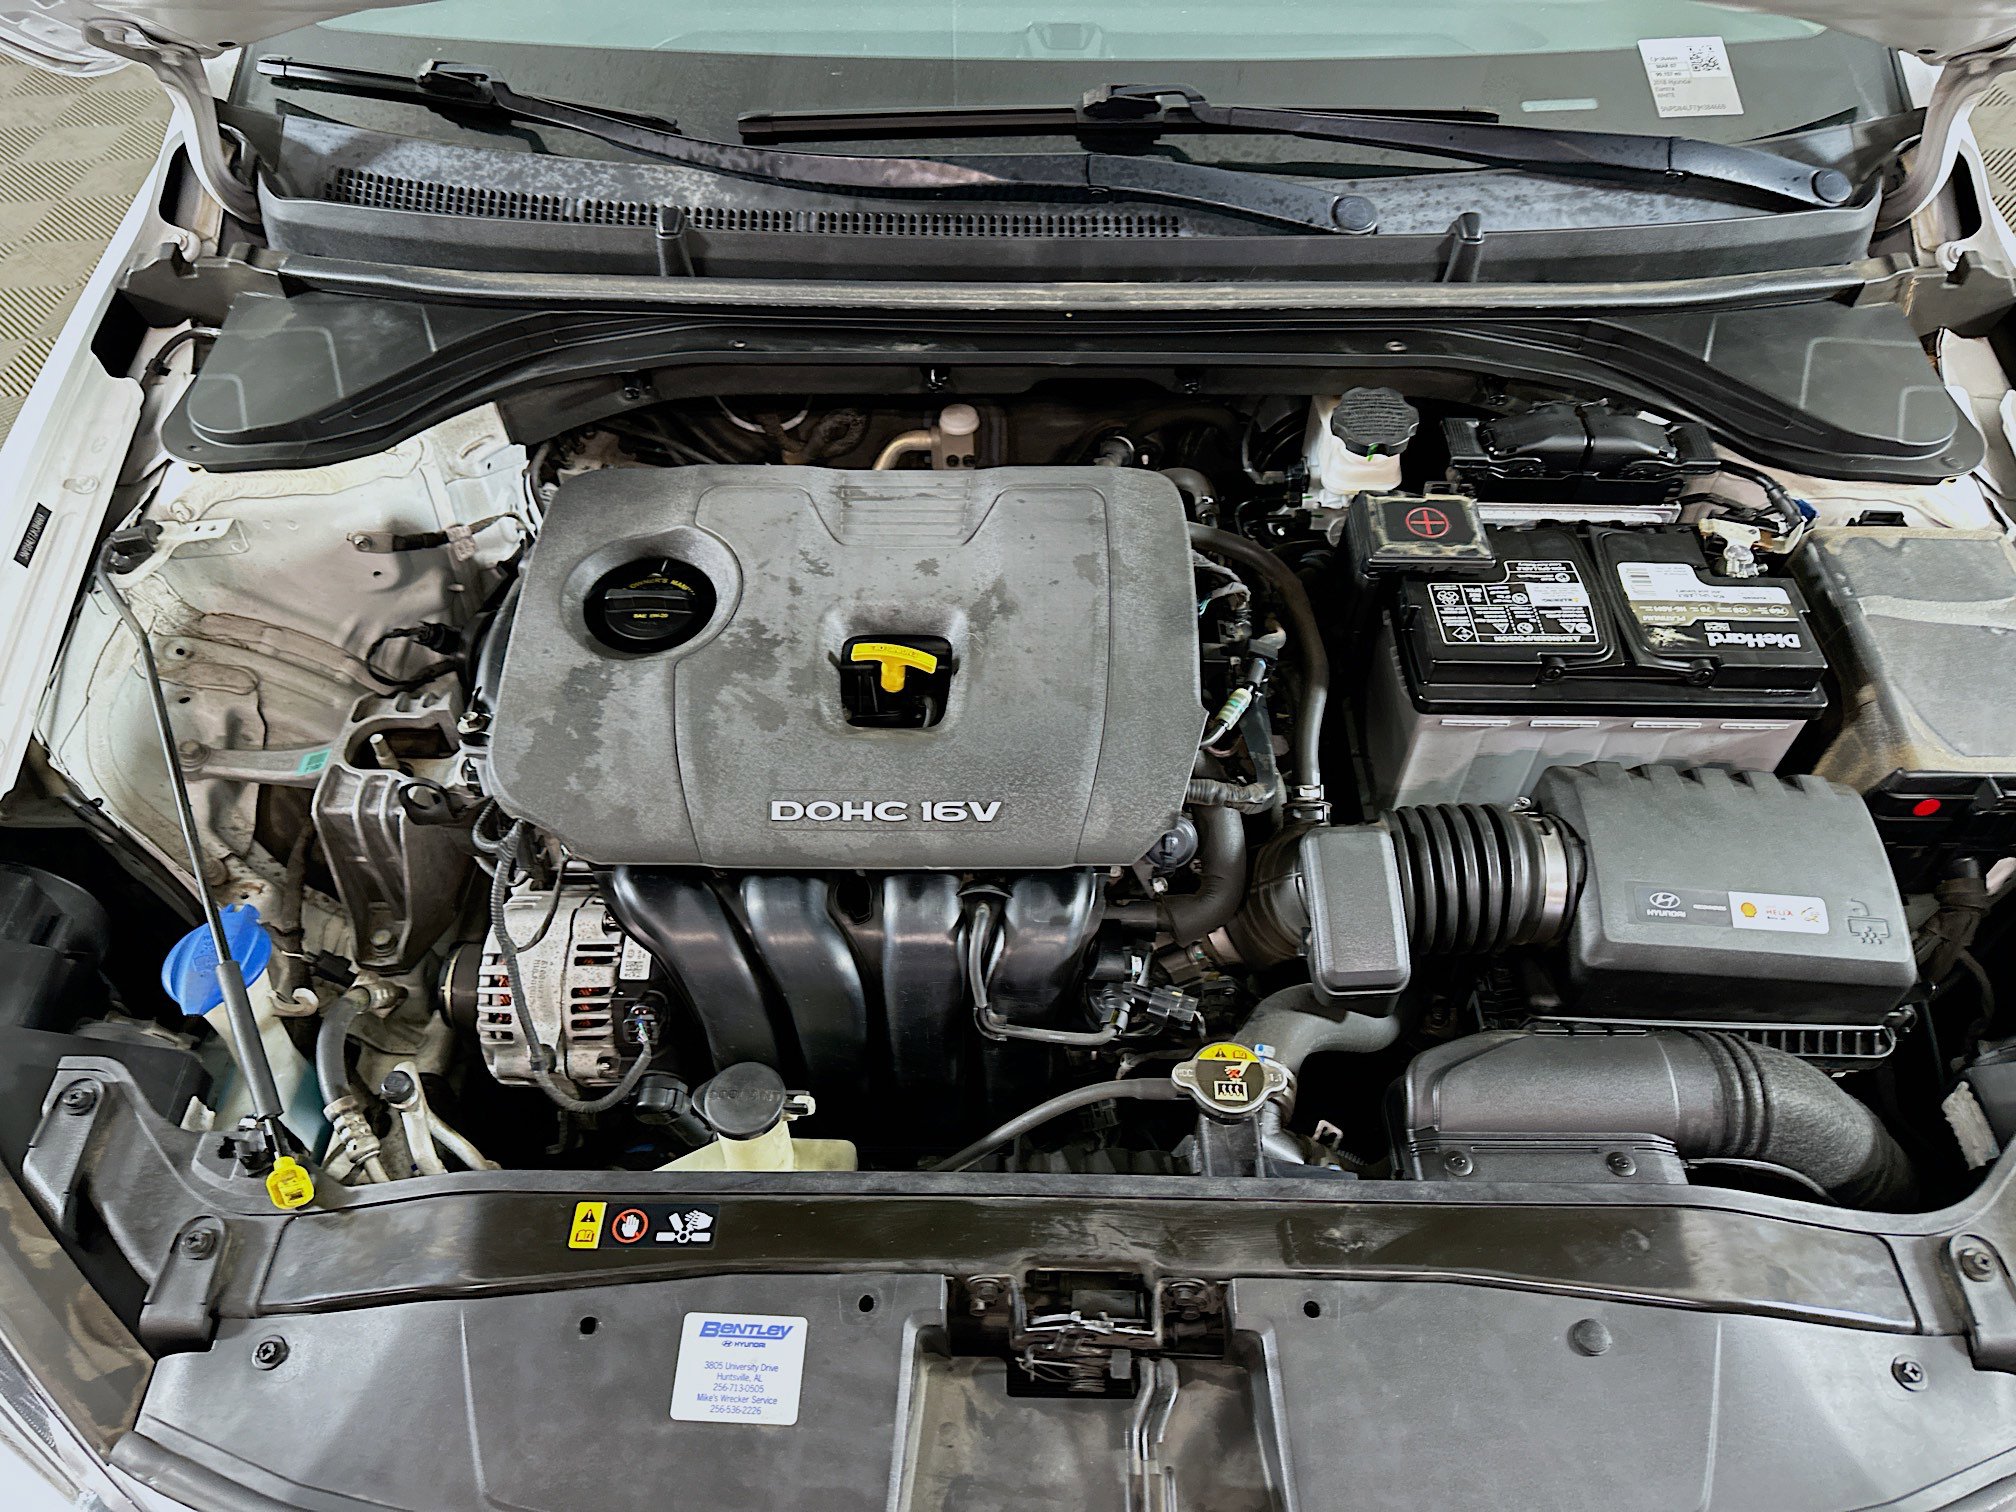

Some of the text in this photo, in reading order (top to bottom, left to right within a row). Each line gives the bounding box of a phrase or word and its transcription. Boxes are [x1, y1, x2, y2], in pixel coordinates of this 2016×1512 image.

[1704, 631, 1801, 648] DieHard
[771, 801, 1001, 822] DOHC 16V
[1646, 909, 1687, 918] HYUNDAI
[704, 1361, 779, 1373] 3805 University Drive
[716, 1372, 763, 1383] Huntsville, AL
[696, 1393, 778, 1405] Mike's Wrecker Service
